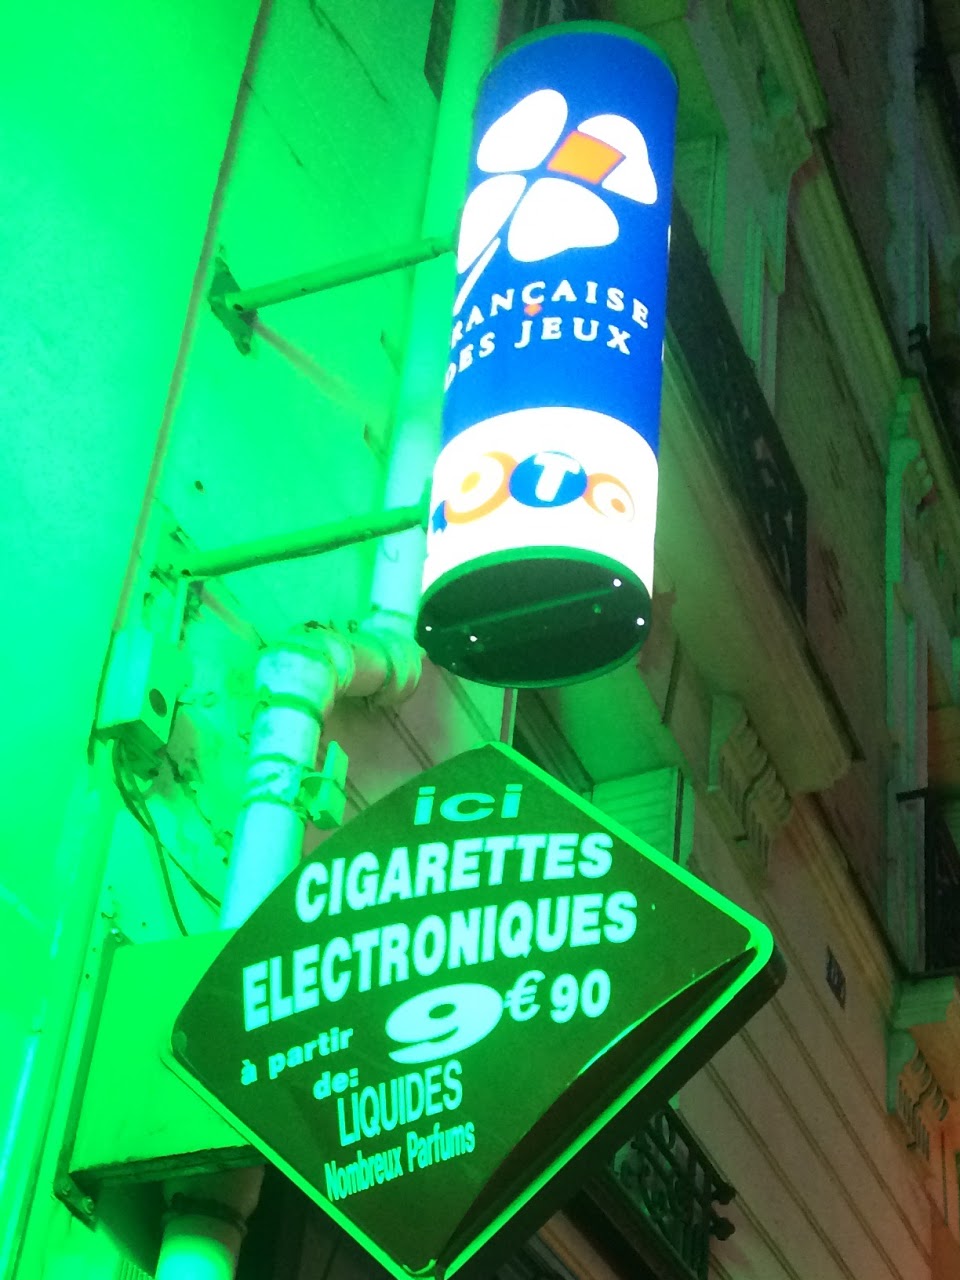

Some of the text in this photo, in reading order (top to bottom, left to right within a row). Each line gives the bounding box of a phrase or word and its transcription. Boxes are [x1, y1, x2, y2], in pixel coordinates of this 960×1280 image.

[451, 279, 649, 349] RANÇAISE
[444, 317, 631, 393] DES JEUX
[413, 784, 523, 825] ici
[295, 832, 613, 923] CIGARETTES
[242, 891, 637, 1031] ELECTRONIQUES
[240, 1027, 353, 1085] à partir
[313, 1068, 359, 1099] de:
[337, 1059, 463, 1146] LIQUIDES
[324, 1122, 476, 1201] Nombreux Parfums
